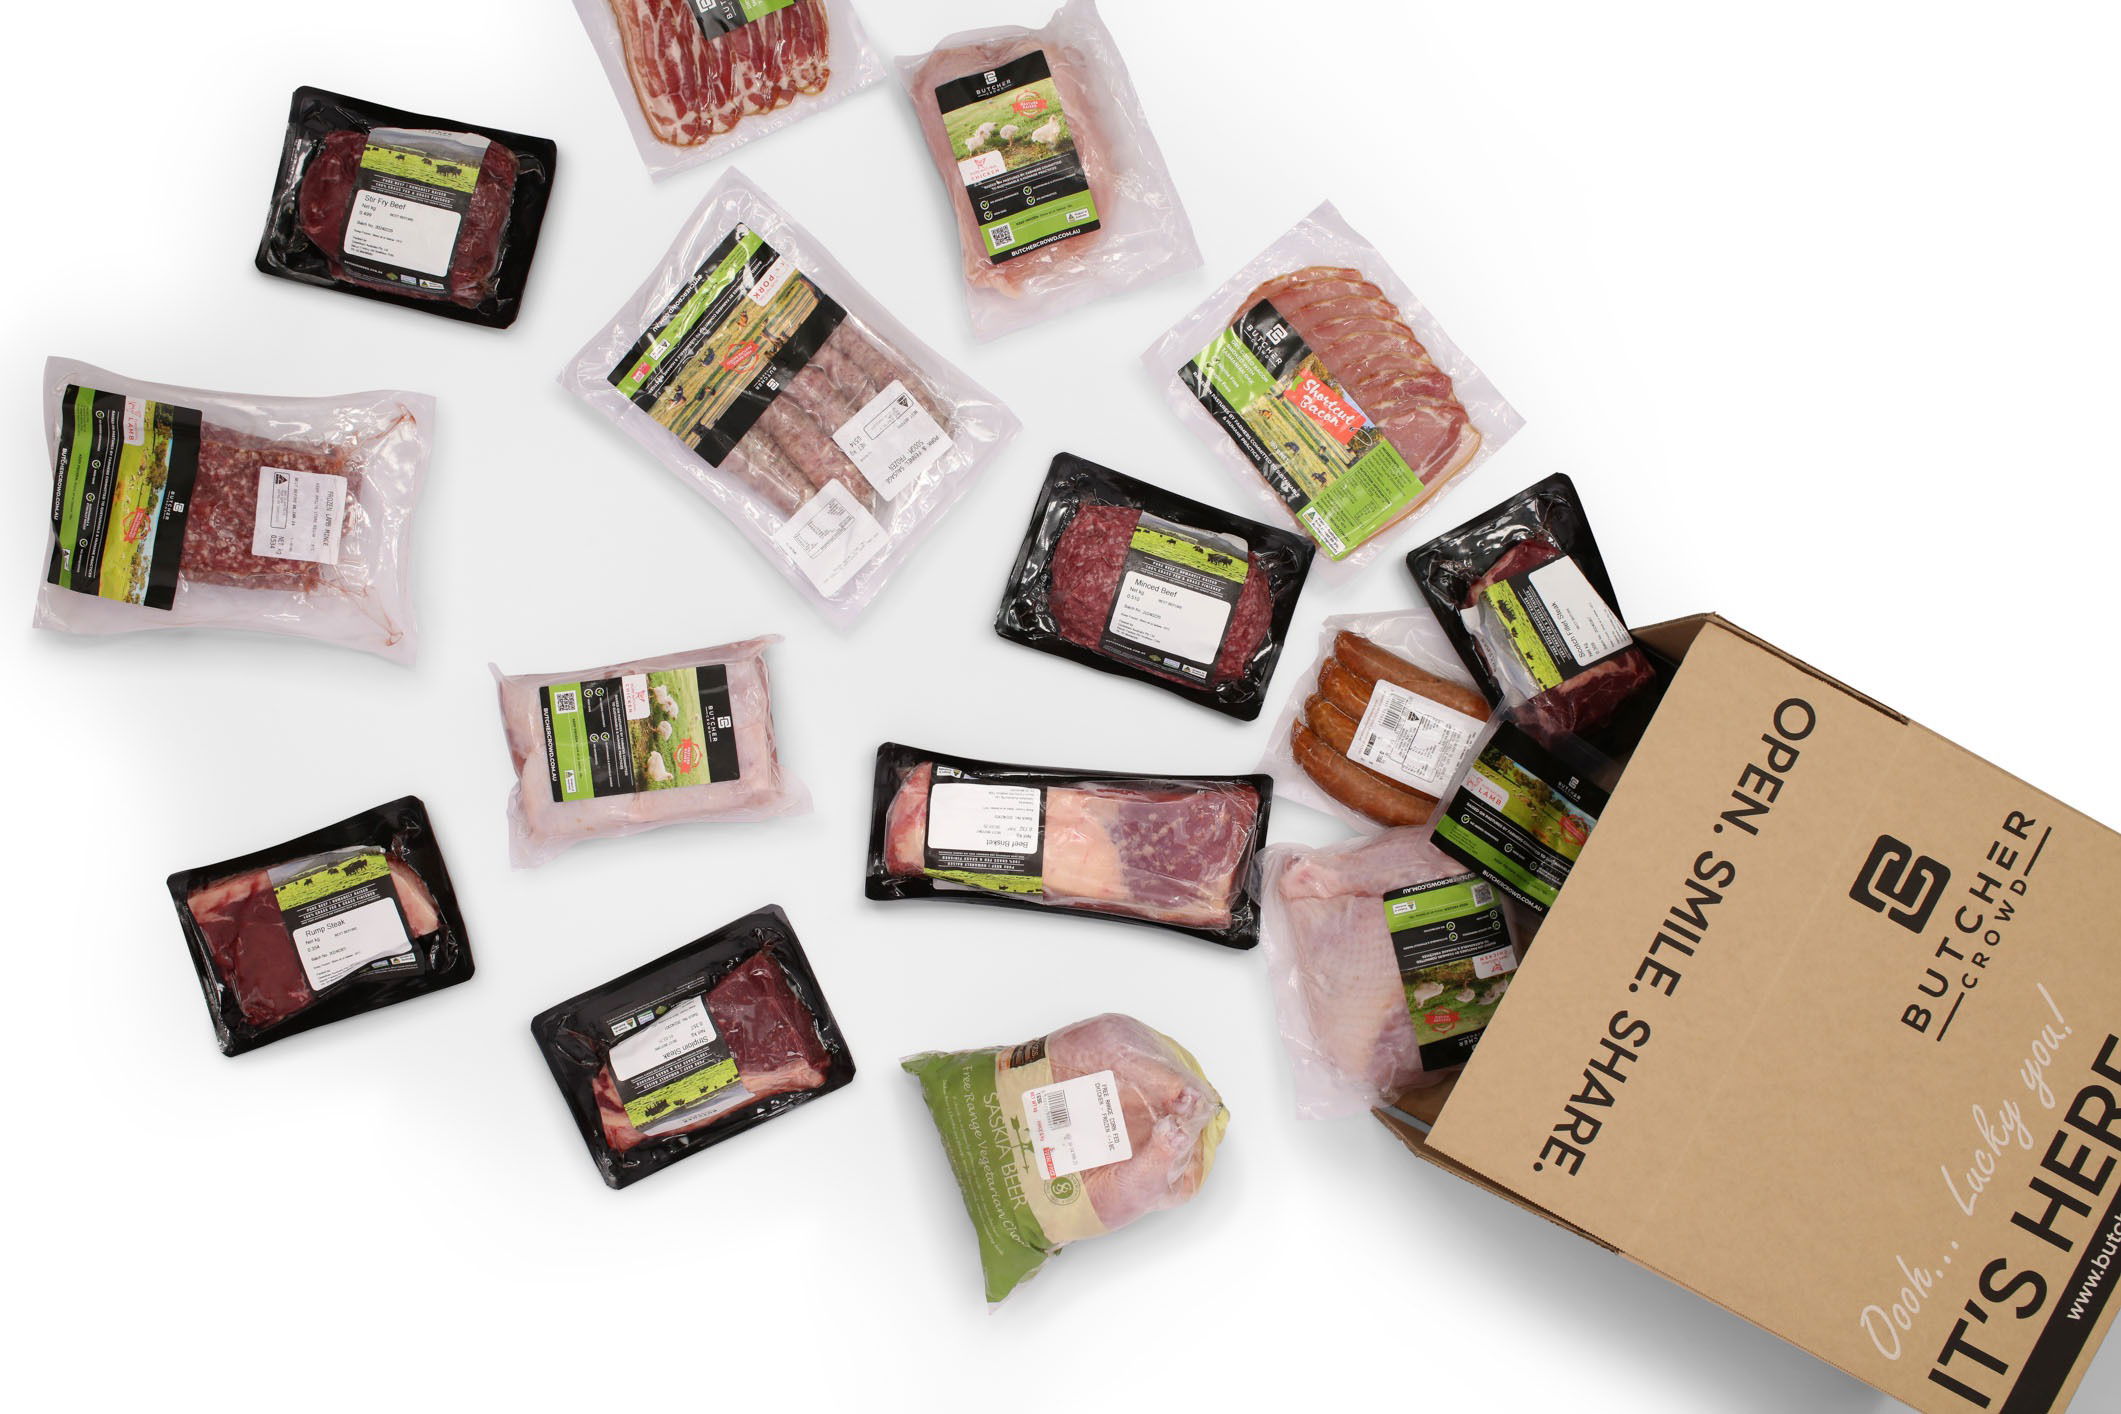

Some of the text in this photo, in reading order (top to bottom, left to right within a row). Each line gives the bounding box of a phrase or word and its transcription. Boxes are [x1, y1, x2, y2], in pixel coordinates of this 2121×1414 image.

[975, 78, 1011, 95] BUTCHER
[364, 194, 406, 210] Stir Fry Beef
[1010, 227, 1081, 256] BUTCHERCROWD.COM.AU
[751, 274, 775, 299] PORK
[1245, 323, 1283, 365] BUTCHER
[1250, 338, 1269, 359] CROWD
[754, 365, 777, 390] BUTCHER
[1299, 394, 1337, 425] Bacon
[1302, 378, 1355, 425] Shortcut
[927, 434, 940, 447] PORK
[1210, 394, 1229, 415] PASTURES
[1232, 419, 1251, 440] FARMERS
[1248, 438, 1270, 463] COMMITTED
[1225, 419, 1242, 438] HUMANE
[1240, 437, 1261, 460] PRACTICES
[887, 453, 906, 471] FROZEN
[904, 450, 922, 466] FENNEL
[52, 447, 67, 520] BUTCHERCROWD.COM.AU
[885, 465, 905, 484] SAUSAGE
[164, 490, 174, 521] BUTCHER
[325, 490, 334, 511] FROZEN
[321, 529, 330, 546] MINCE
[1134, 578, 1177, 597] Minced Beef
[1549, 601, 1586, 658] Scotch Fillet Steak
[624, 683, 632, 712] CHICKEN
[707, 705, 717, 741] BUTCHER
[542, 707, 558, 781] BUTCHERCROWD.COM.AU
[1477, 786, 1503, 806] LAMB
[986, 839, 1028, 848] Beef Brisket
[1481, 869, 1543, 912] BUTCHERCROWD.COM.AU
[304, 918, 345, 938] Rump Steak
[1899, 807, 2037, 1033] BUTCHER
[1958, 876, 2029, 991] CROWD
[1533, 696, 1817, 1177] OPEN. SMILE. SHARE.
[662, 1034, 708, 1060] Striploin Steak
[1458, 1036, 1478, 1046] CHER
[961, 1063, 974, 1090] Free
[1101, 1083, 1109, 1097] FREE
[1094, 1082, 1104, 1105] CHICKEN
[1101, 1112, 1110, 1132] FROZEN
[1104, 1099, 1113, 1115] RANGE
[1941, 1097, 2034, 1216] Lucky
[2019, 981, 2073, 1109] you!
[963, 1092, 983, 1138] Range
[1109, 1117, 1117, 1131] CORN
[981, 1091, 1027, 1210] SASKIA BEER
[979, 1140, 1006, 1219] Vegetarian
[1927, 1033, 2121, 1410] IT'S HER
